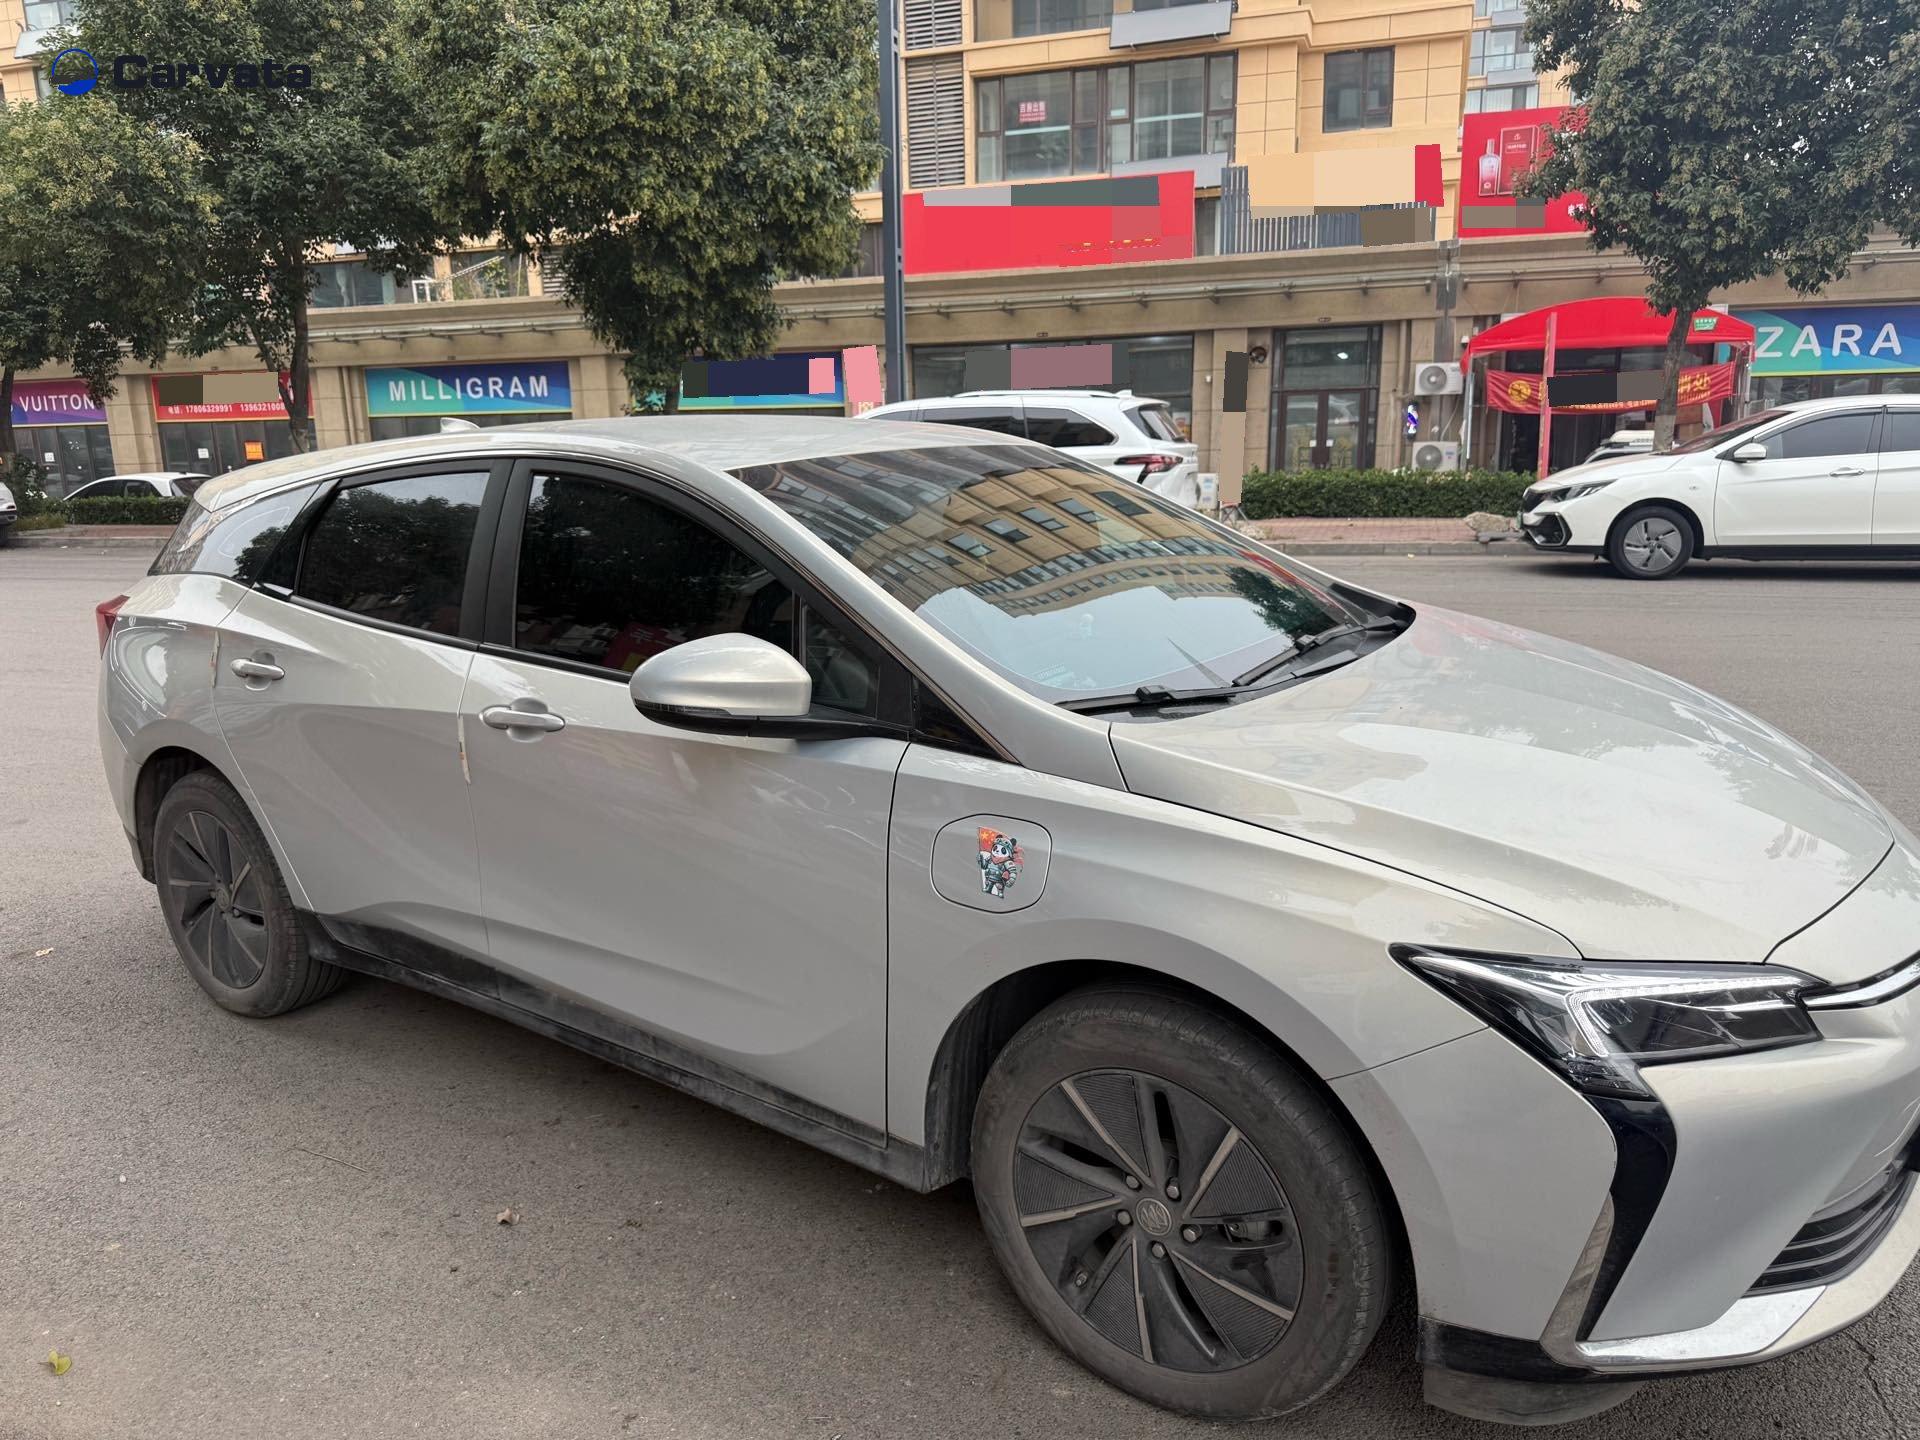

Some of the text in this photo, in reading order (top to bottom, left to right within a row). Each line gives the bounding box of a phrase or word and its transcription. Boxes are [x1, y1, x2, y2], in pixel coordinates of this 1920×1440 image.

[1755, 323, 1902, 357] ZARA
[388, 375, 548, 401] MILLIGRAM
[19, 394, 95, 412] VUITTON
